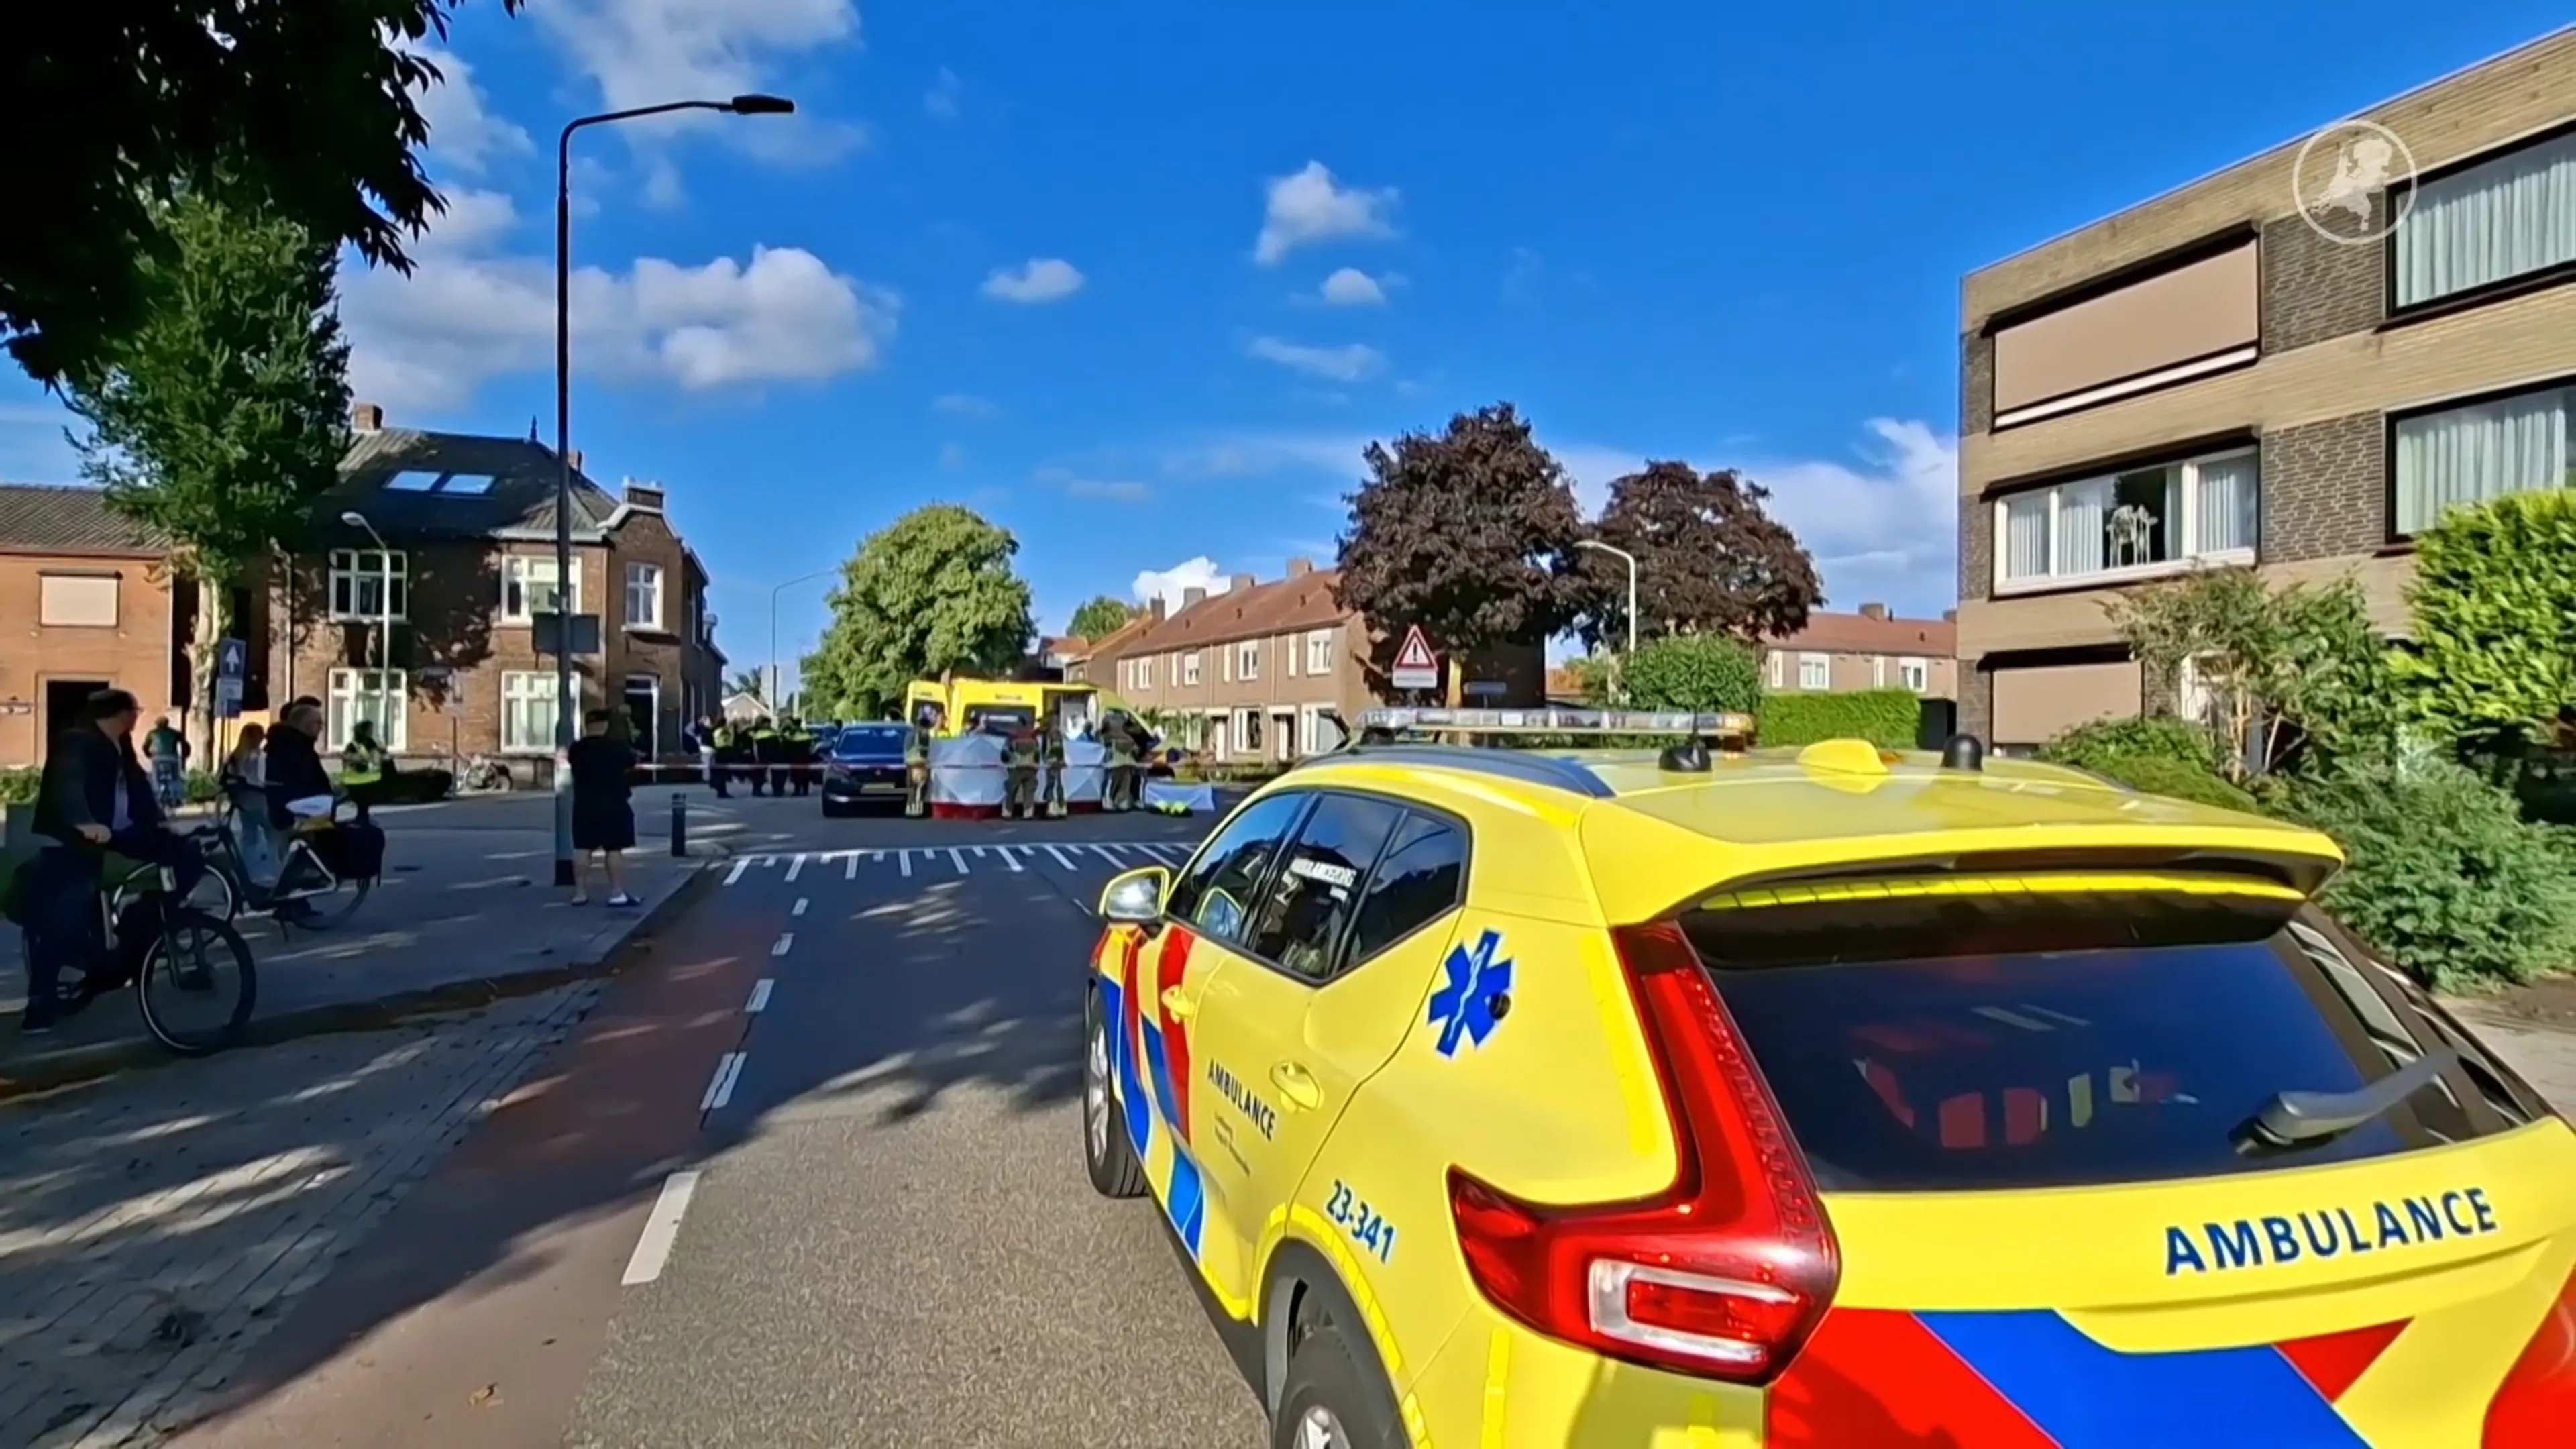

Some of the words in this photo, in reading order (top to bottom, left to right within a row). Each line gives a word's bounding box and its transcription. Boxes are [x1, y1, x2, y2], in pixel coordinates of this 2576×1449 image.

[1208, 1057, 1275, 1142] AMBULANCE
[1326, 1178, 1394, 1265] 23-341
[2165, 1187, 2498, 1276] AMBULANCE
